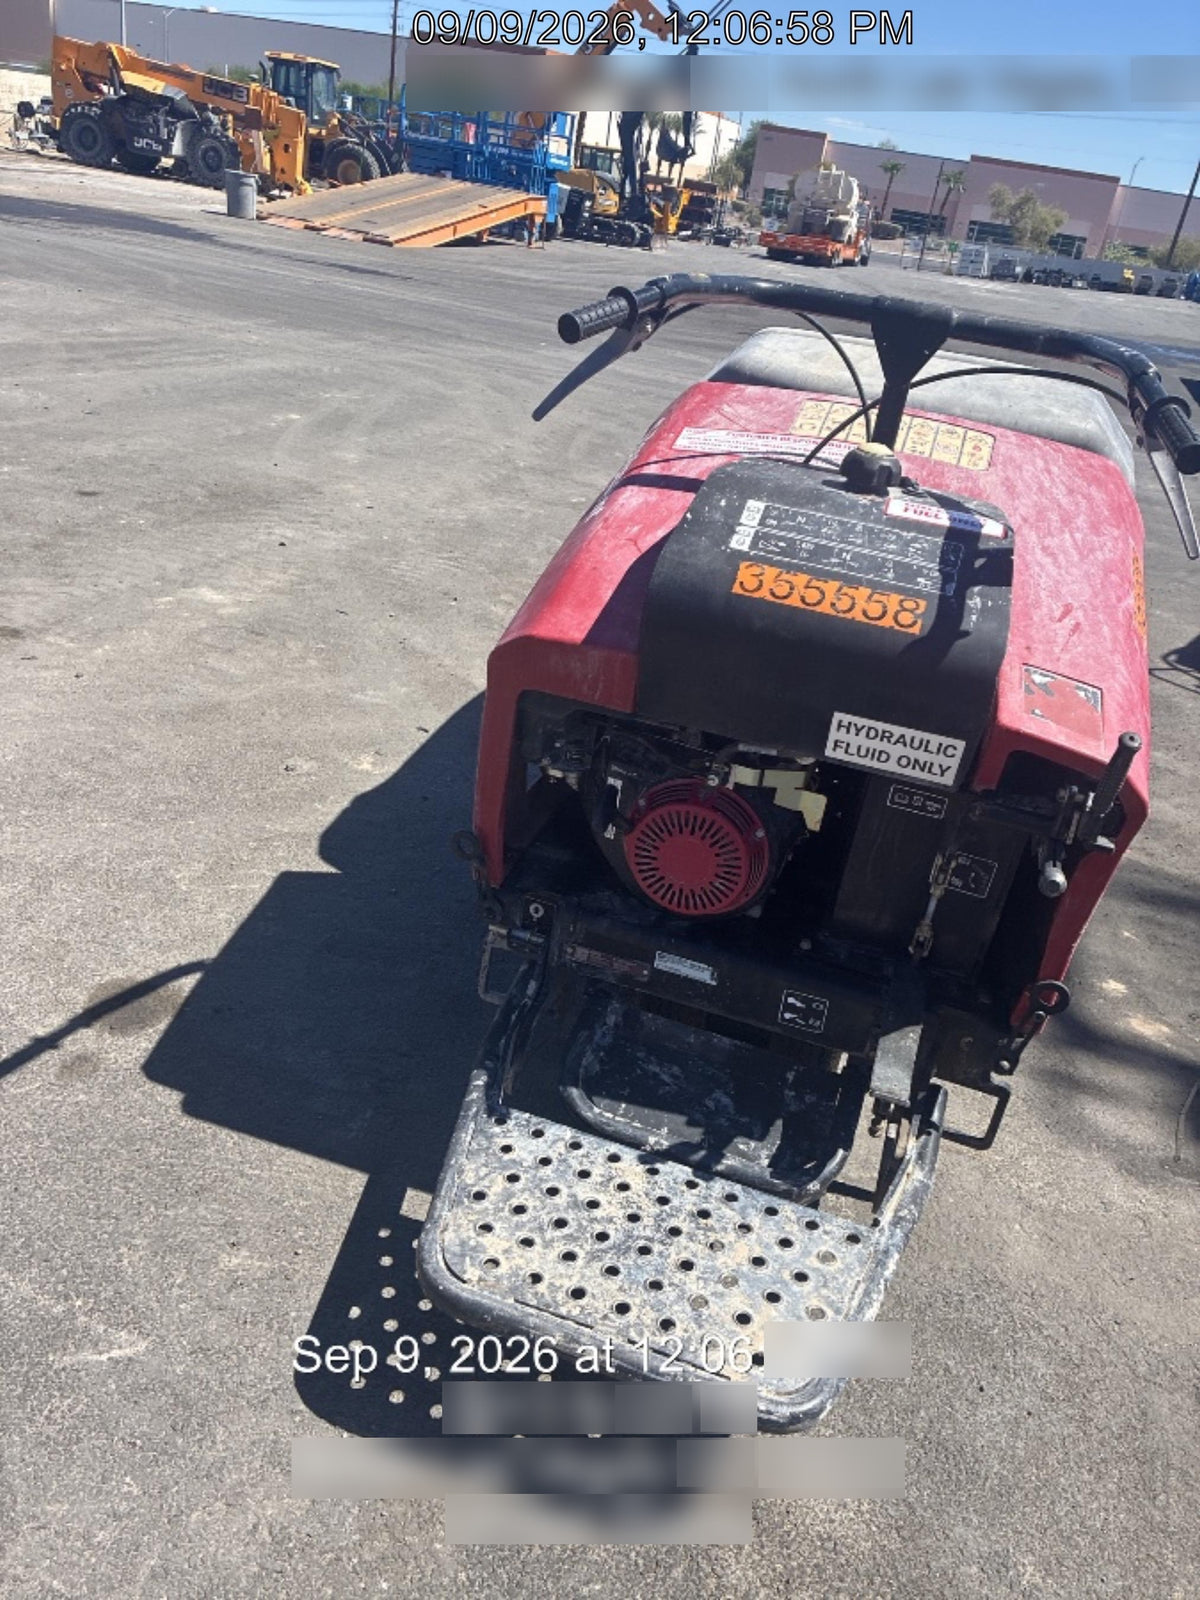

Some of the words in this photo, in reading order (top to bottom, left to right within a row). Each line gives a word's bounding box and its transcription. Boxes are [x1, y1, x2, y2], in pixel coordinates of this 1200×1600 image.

[204, 77, 248, 102] JCB
[738, 563, 921, 629] 355558
[832, 739, 891, 764] FLUID
[896, 755, 953, 778] ONLY
[836, 719, 958, 759] HYDRAULIC
